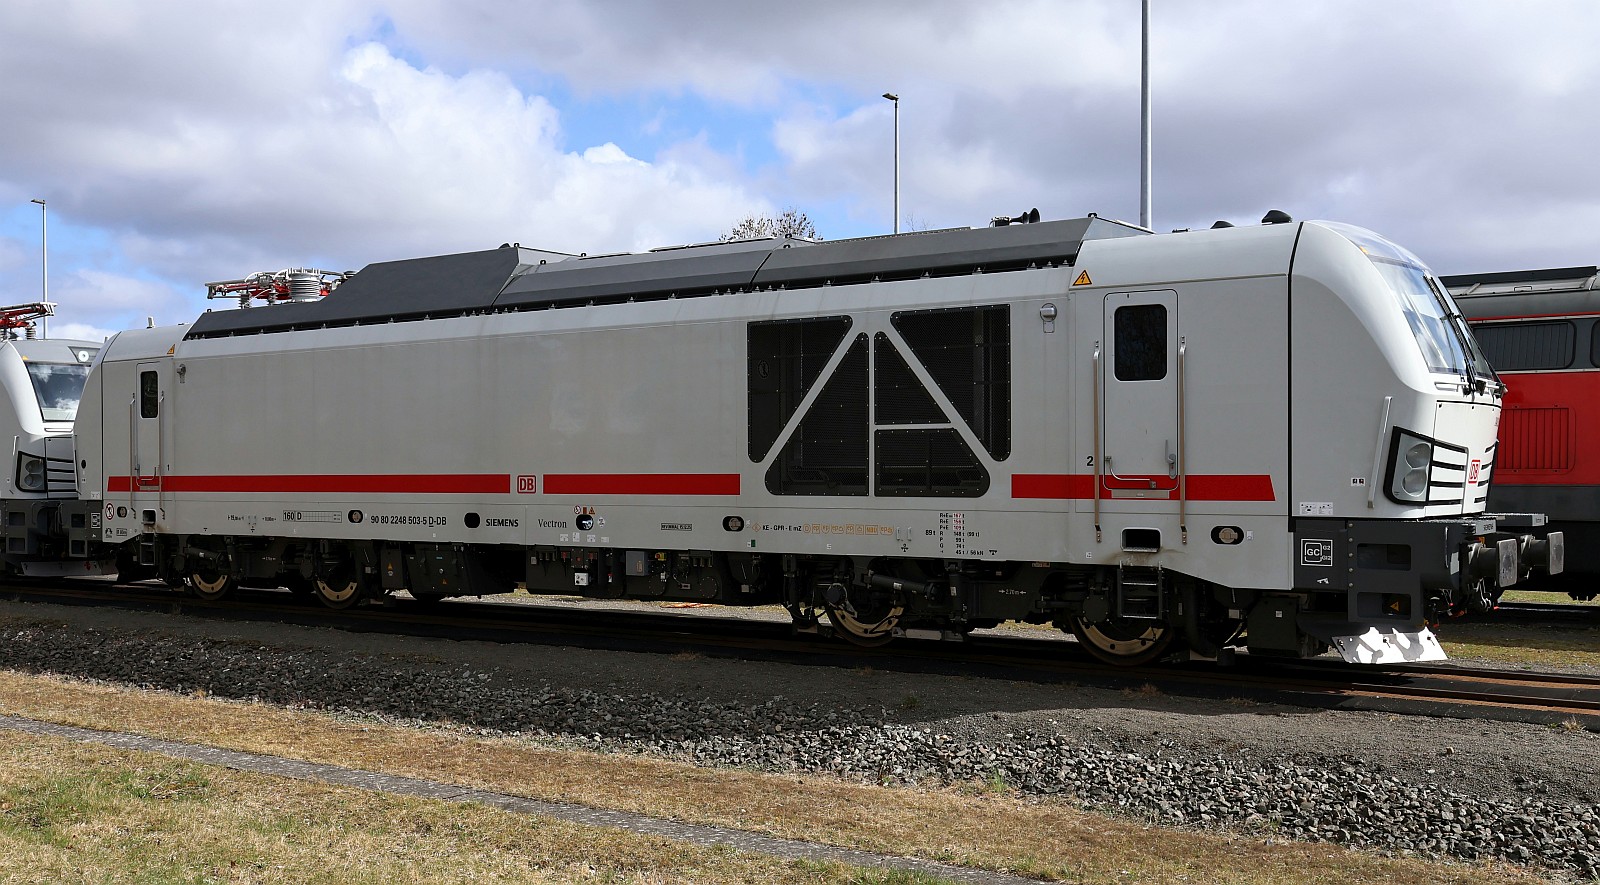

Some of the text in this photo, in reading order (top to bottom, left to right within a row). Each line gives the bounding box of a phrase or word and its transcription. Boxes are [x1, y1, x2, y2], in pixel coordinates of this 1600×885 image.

[1086, 455, 1094, 466] 2
[519, 477, 534, 491] DB
[283, 511, 294, 521] 160
[296, 512, 302, 520] D
[370, 515, 447, 528] 90 80 2248 503-5 D-DB
[485, 518, 519, 528] SIEMENS
[538, 519, 567, 529] Vectron
[1306, 548, 1320, 556] GC
